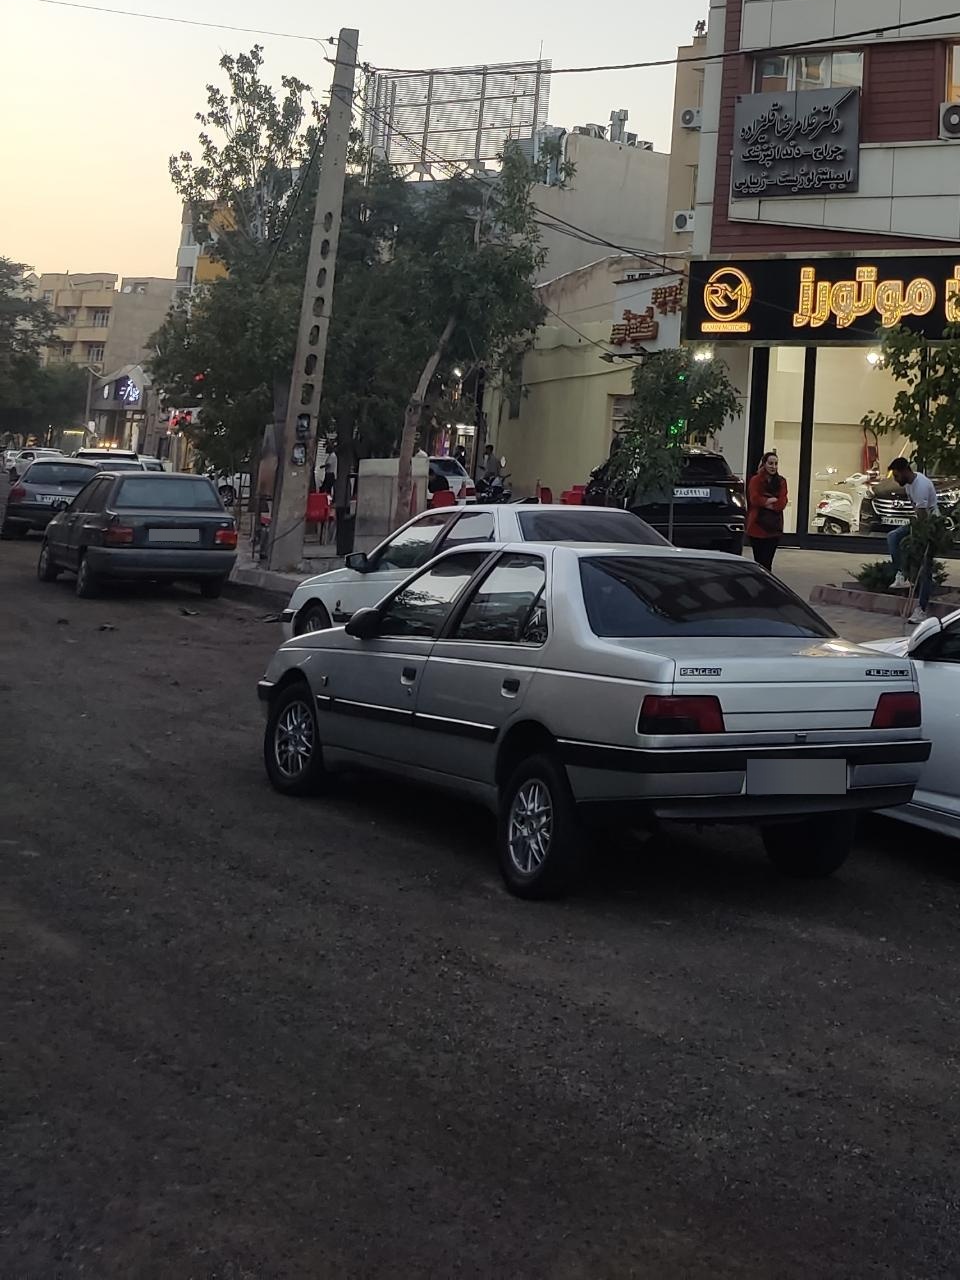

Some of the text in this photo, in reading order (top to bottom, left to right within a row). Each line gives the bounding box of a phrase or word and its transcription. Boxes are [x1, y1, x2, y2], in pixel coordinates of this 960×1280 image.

[773, 106, 819, 141] غلامرضا
[808, 88, 857, 141] دکتر
[741, 140, 802, 168] دندانپزشک
[812, 143, 845, 161] جراح
[733, 171, 767, 193] زیبایی
[777, 167, 853, 192] ایمپلنتولوژیست
[793, 266, 936, 328] موتورز
[680, 667, 721, 676] PEUGEOT
